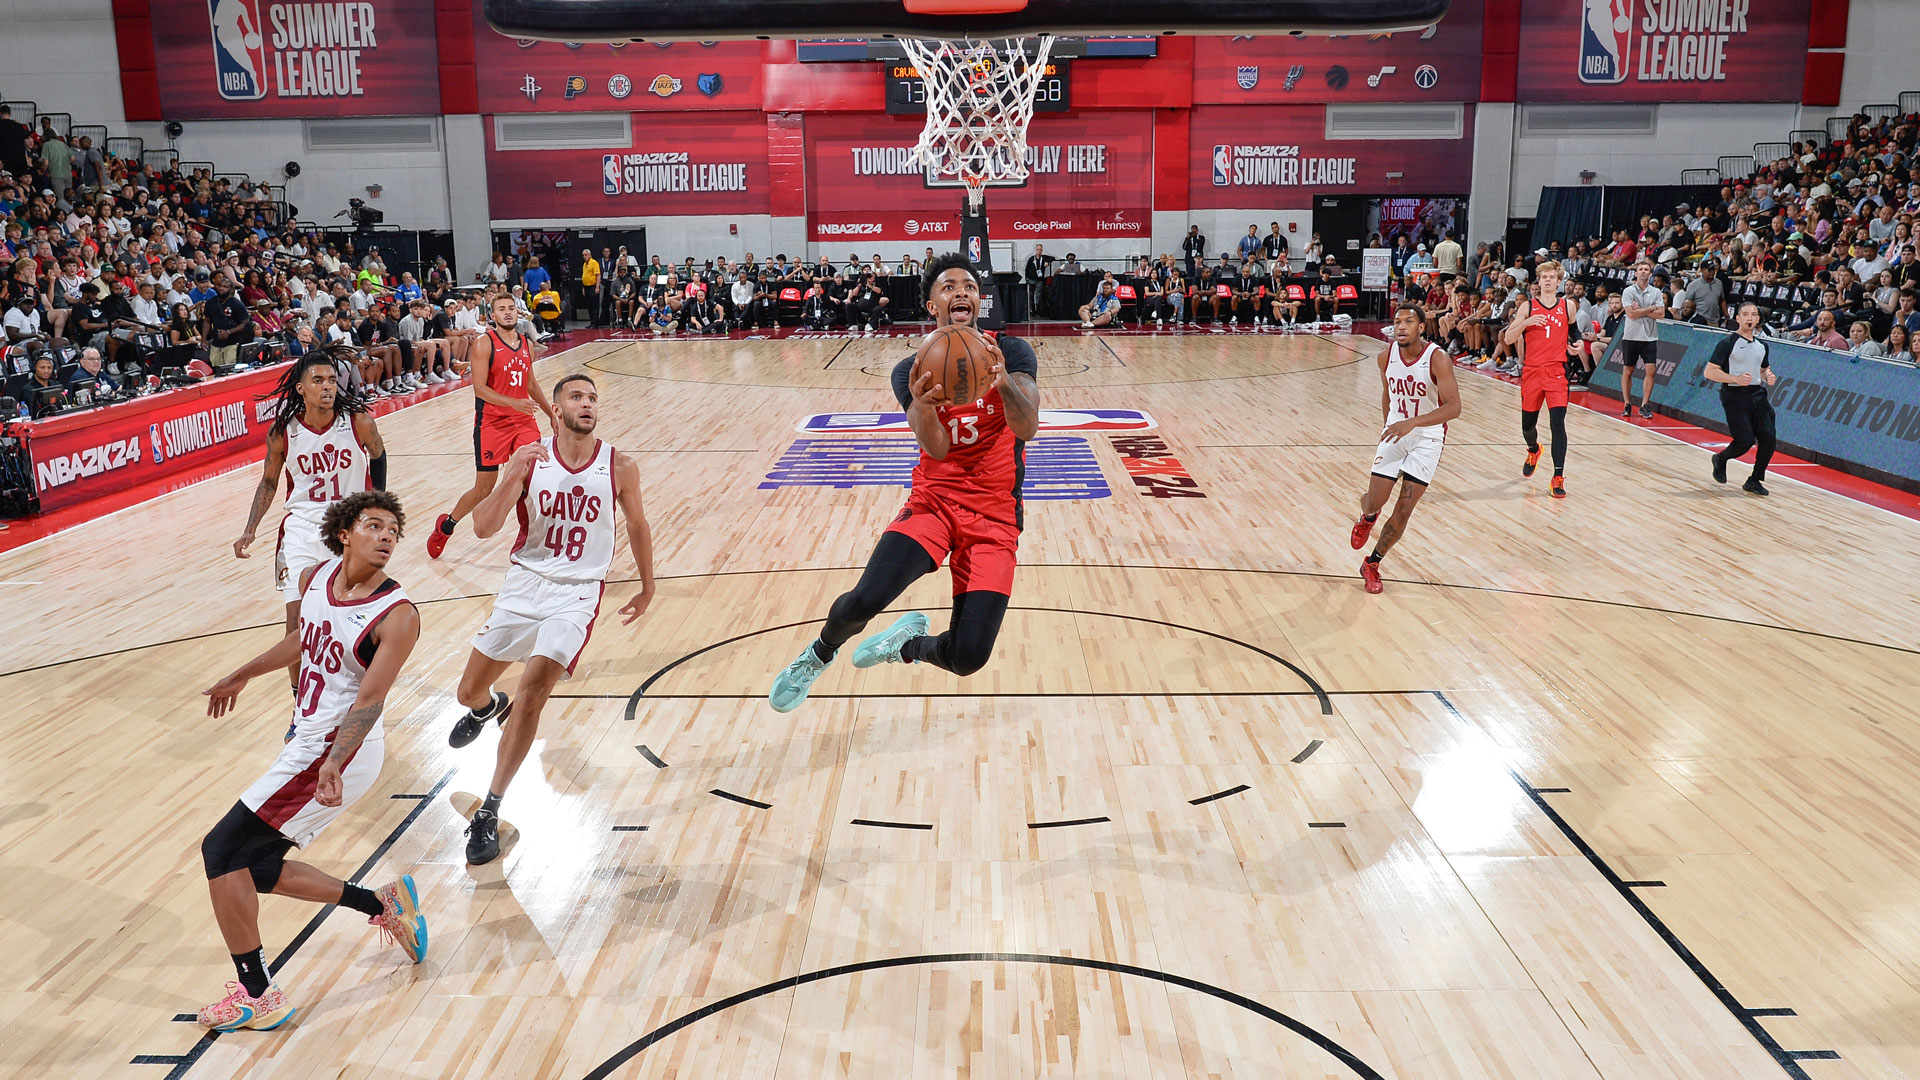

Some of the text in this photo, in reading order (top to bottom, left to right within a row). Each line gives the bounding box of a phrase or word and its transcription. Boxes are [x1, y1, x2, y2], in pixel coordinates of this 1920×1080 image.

[270, 2, 377, 49] SUMMER
[1642, 0, 1750, 33] SUMMER
[1585, 56, 1609, 74] NBA
[1638, 35, 1729, 80] LEAGUE
[224, 72, 248, 91] NBA
[274, 50, 364, 97] LEAGUE
[900, 81, 926, 103] 73
[1034, 79, 1062, 101] 58
[623, 152, 689, 165] NBA2K24
[1024, 146, 1061, 173] PLAY
[1067, 145, 1106, 173] HERE
[1234, 145, 1299, 156] NBA2K24
[624, 163, 747, 193] SUMMER LEAGUE
[1233, 158, 1356, 185] SUMMER LEAGUE
[1391, 207, 1415, 220] LEAGUE
[821, 223, 883, 234] NBA2K24
[921, 222, 949, 232] AT&T
[1013, 221, 1071, 232] Google Pixel
[1096, 221, 1141, 231] Hennessy
[1544, 325, 1551, 339] 1
[509, 370, 523, 387] 31
[1388, 376, 1427, 397] CAVS
[1398, 398, 1420, 418] 47
[1785, 379, 1860, 427] TRUTH
[1856, 396, 1896, 434] TO
[1885, 403, 1920, 442] NB
[163, 400, 248, 459] SUMMER LEAGUE
[947, 415, 979, 445] 13
[37, 436, 141, 492] NBA2K24
[296, 446, 352, 475] CAVS
[1108, 435, 1208, 498] NBA2K24
[309, 473, 342, 503] 21
[538, 487, 602, 523] CAVS
[544, 524, 587, 562] 48
[347, 616, 365, 629] CLIFFS
